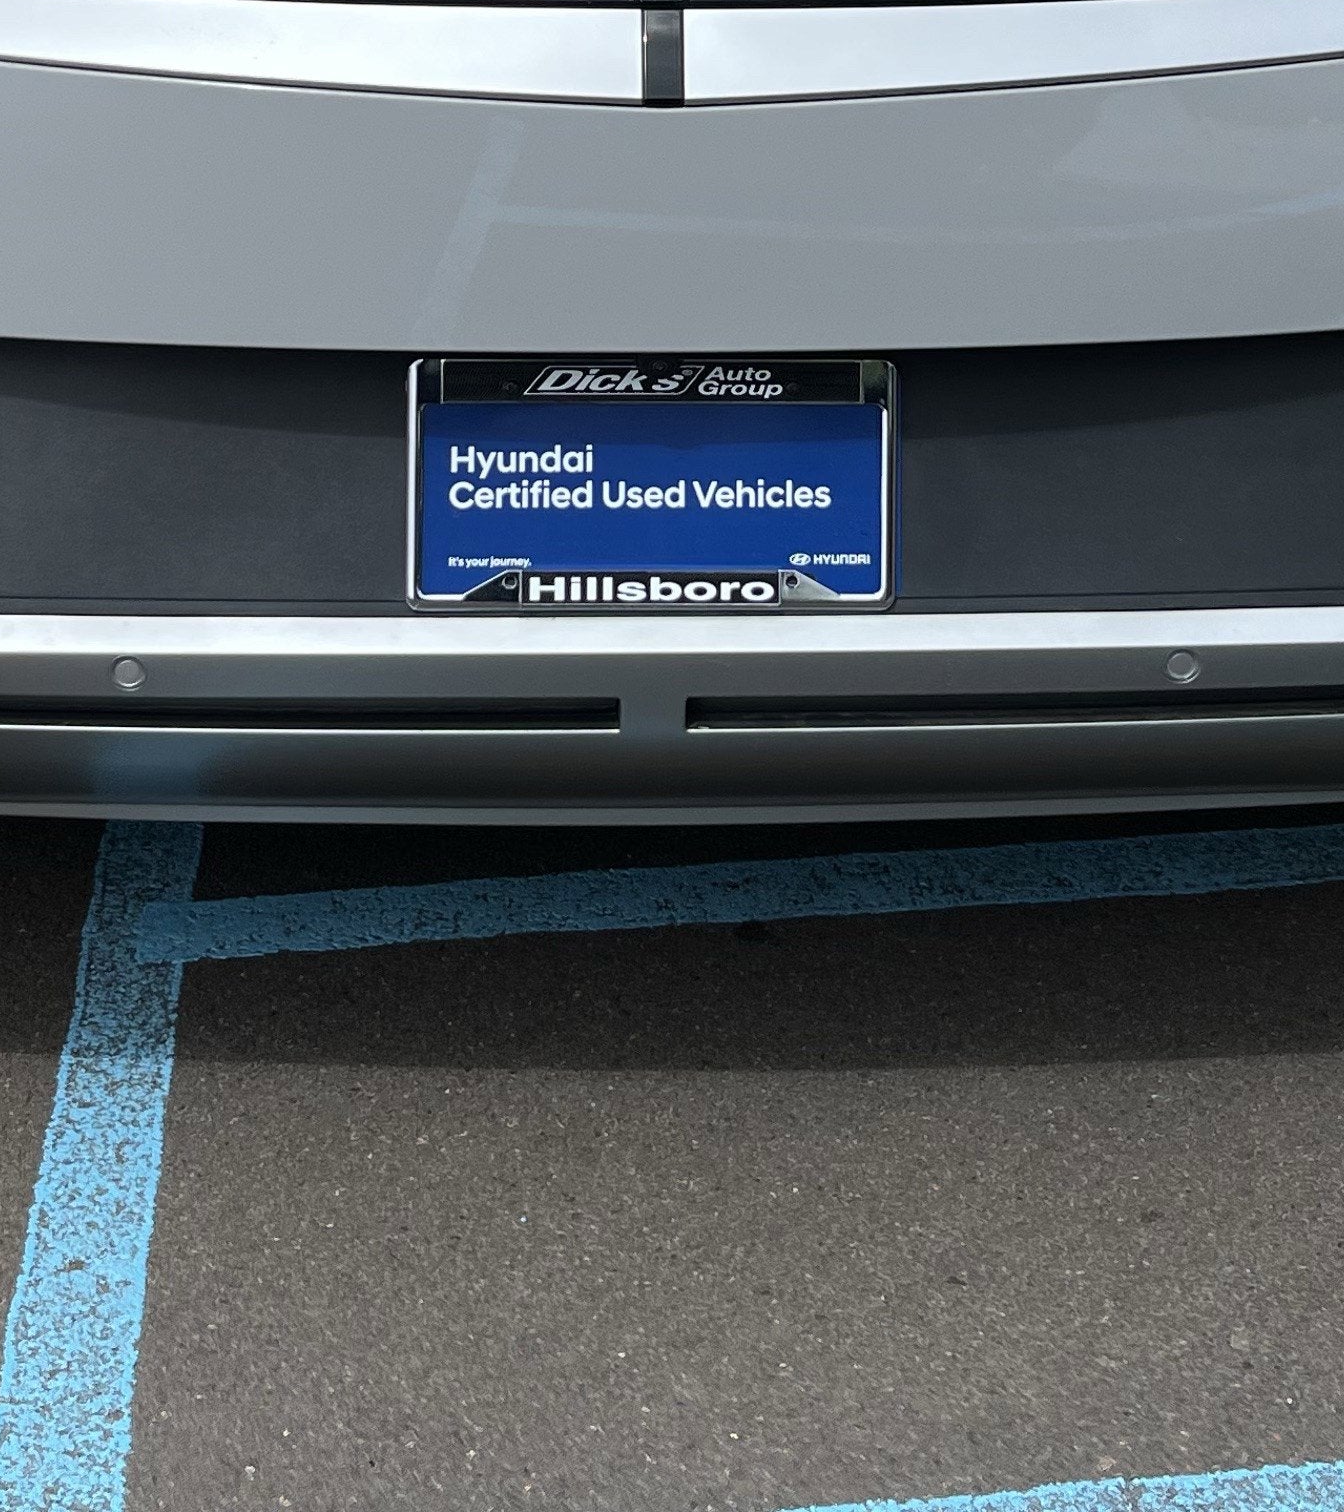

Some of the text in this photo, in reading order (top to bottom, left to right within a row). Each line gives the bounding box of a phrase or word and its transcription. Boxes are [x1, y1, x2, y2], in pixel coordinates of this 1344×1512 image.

[537, 368, 685, 392] Dicks
[704, 366, 772, 382] Auto
[698, 381, 784, 399] Group
[449, 444, 594, 479] Hyundai
[448, 479, 832, 509] Certified Used Vehicles
[465, 557, 490, 569] your
[813, 553, 871, 565] HYUNDAI
[528, 576, 775, 601] Hillsboro
